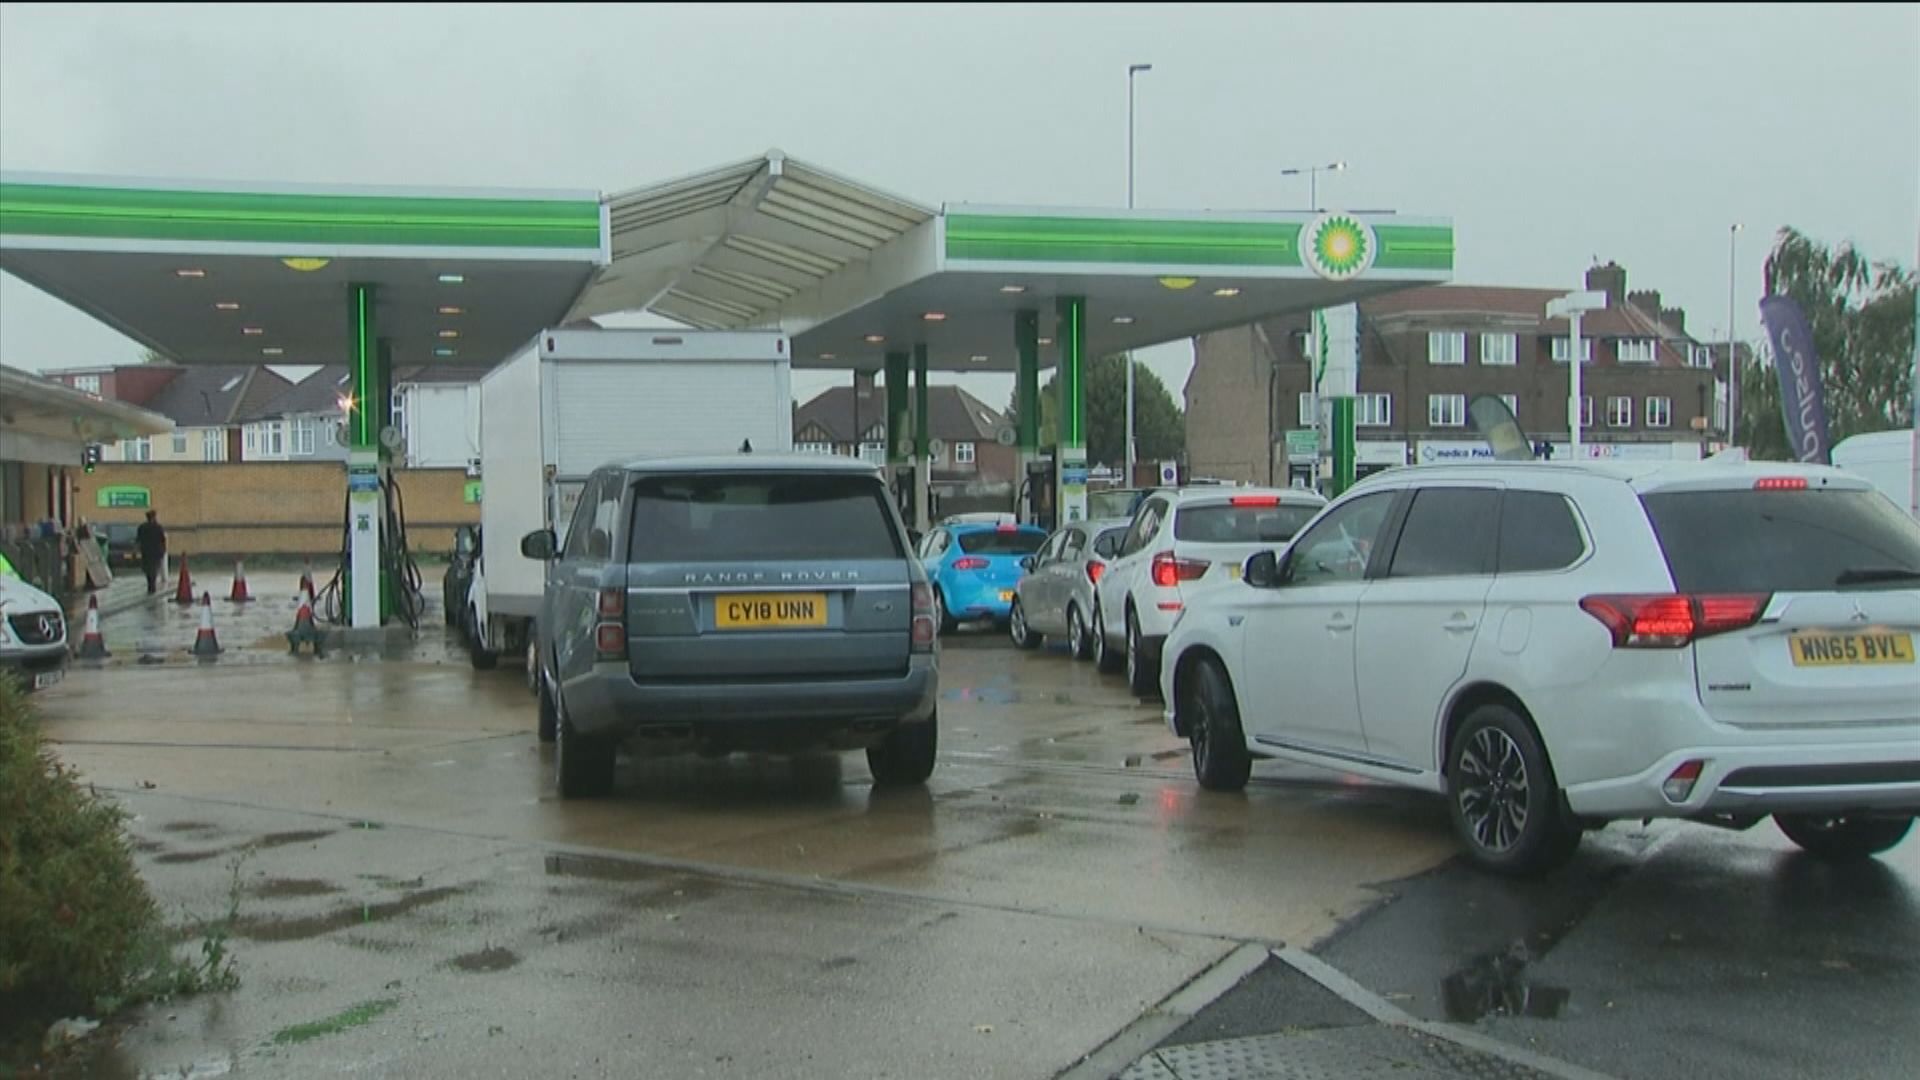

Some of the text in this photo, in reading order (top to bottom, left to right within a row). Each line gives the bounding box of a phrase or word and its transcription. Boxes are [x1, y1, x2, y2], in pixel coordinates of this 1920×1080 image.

[685, 570, 859, 583] RANGE ROVER
[728, 601, 814, 621] CY18 UNN
[1800, 633, 1905, 661] WN65 BVL
